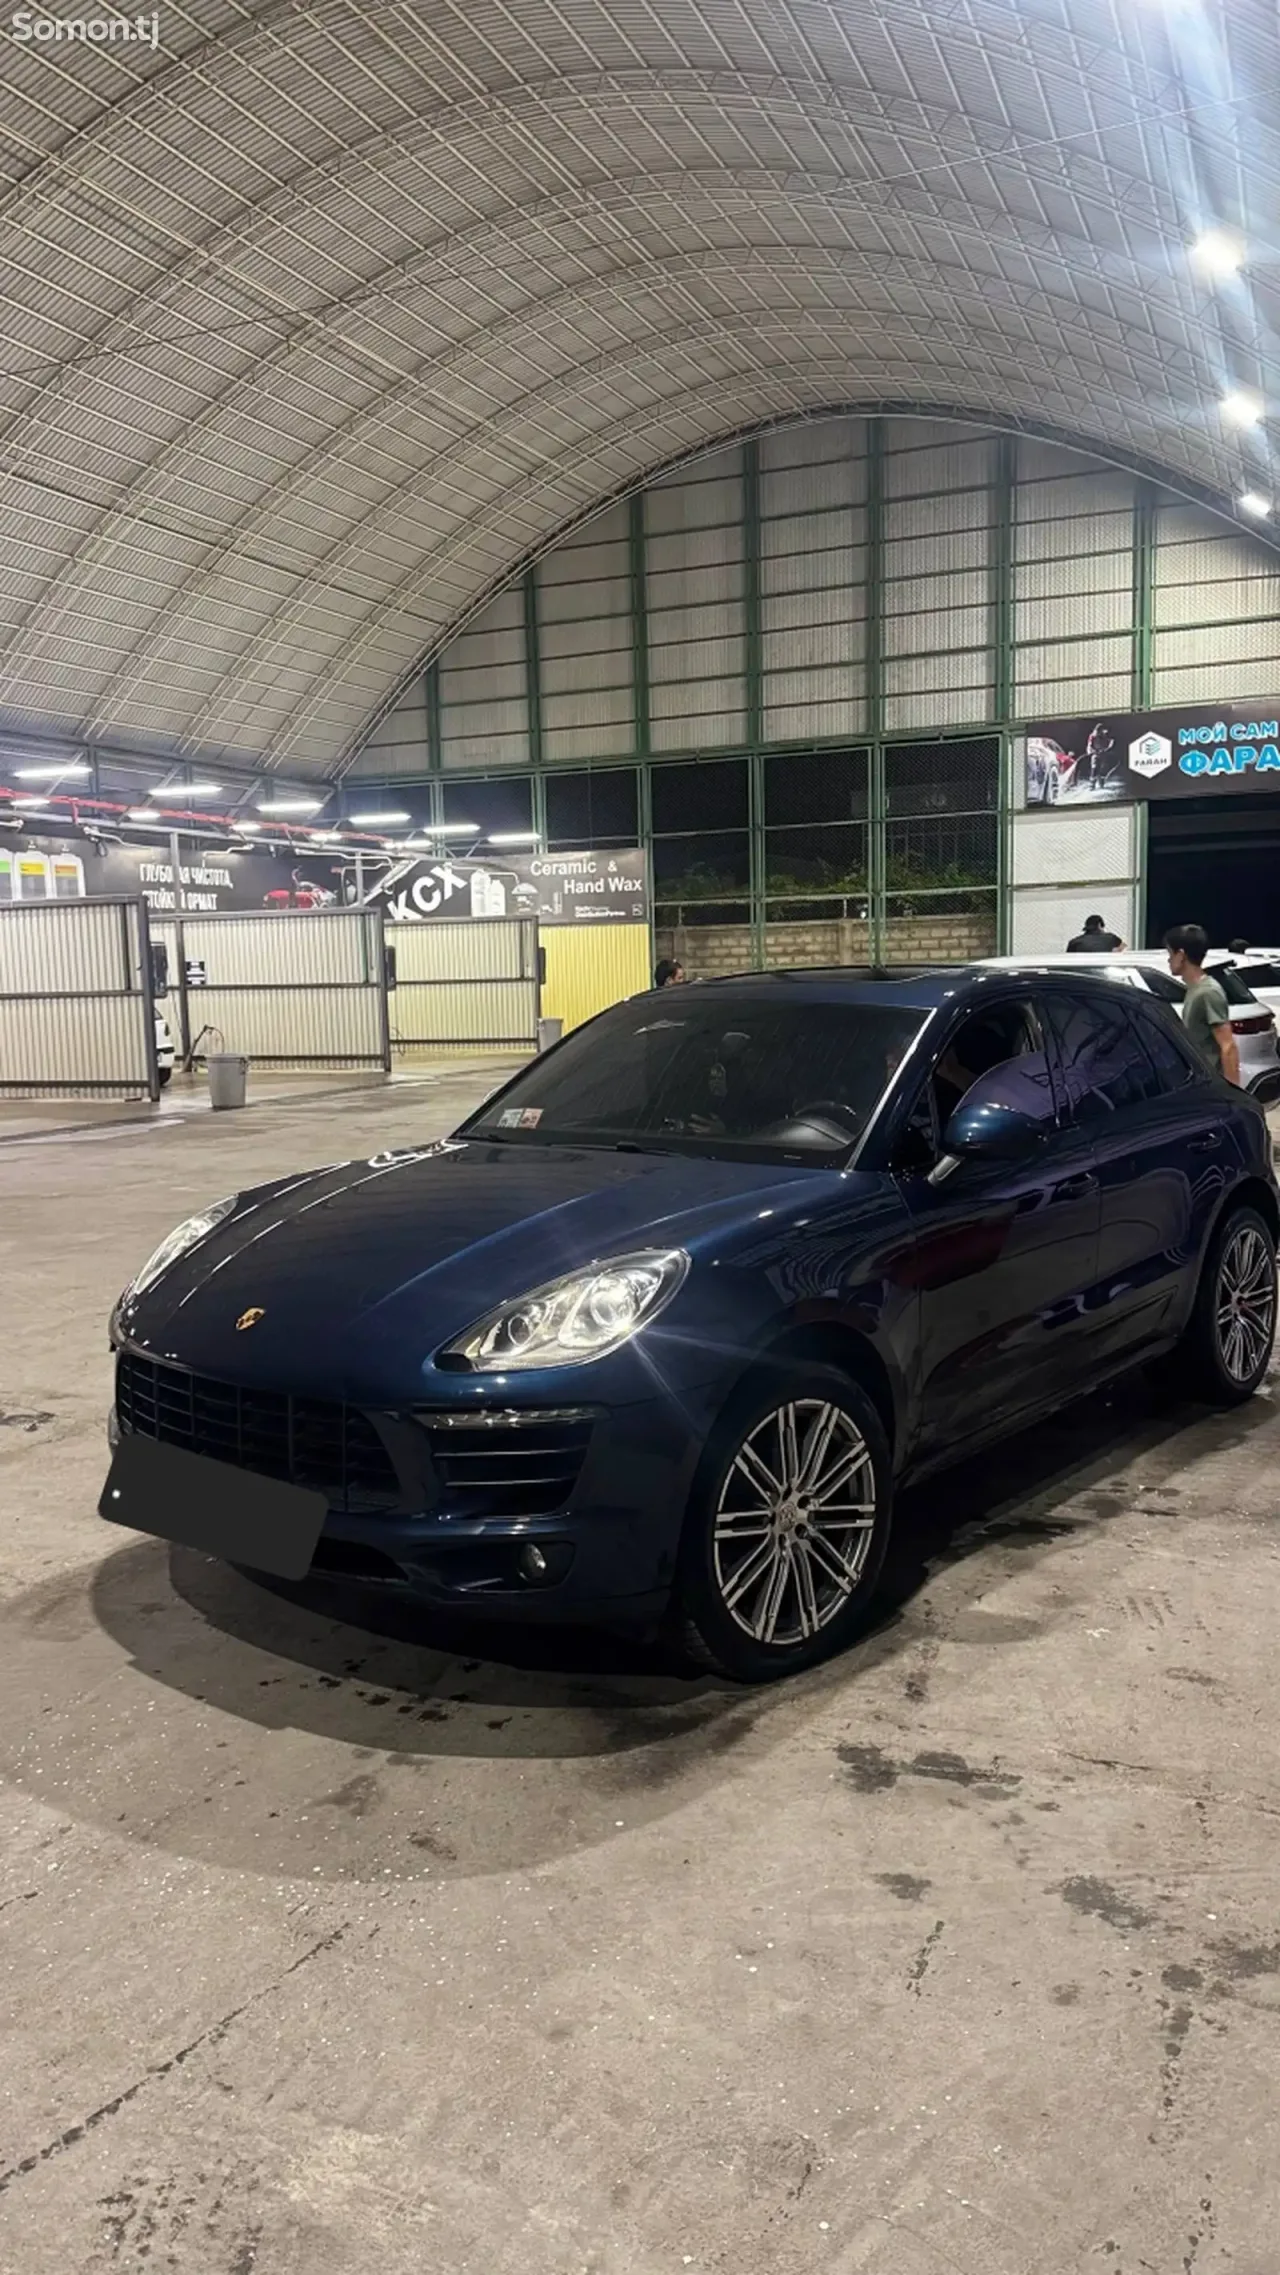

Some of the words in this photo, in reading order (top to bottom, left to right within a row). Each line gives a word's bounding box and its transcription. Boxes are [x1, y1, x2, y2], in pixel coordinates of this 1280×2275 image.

[1178, 721, 1227, 745] МОЙ
[1230, 721, 1278, 741] САМ
[1178, 744, 1280, 777] ФАРА
[530, 858, 597, 876] Ceramic
[607, 860, 617, 872] &
[386, 865, 468, 919] KCX
[564, 878, 605, 895] Hand
[607, 876, 642, 892] Wax
